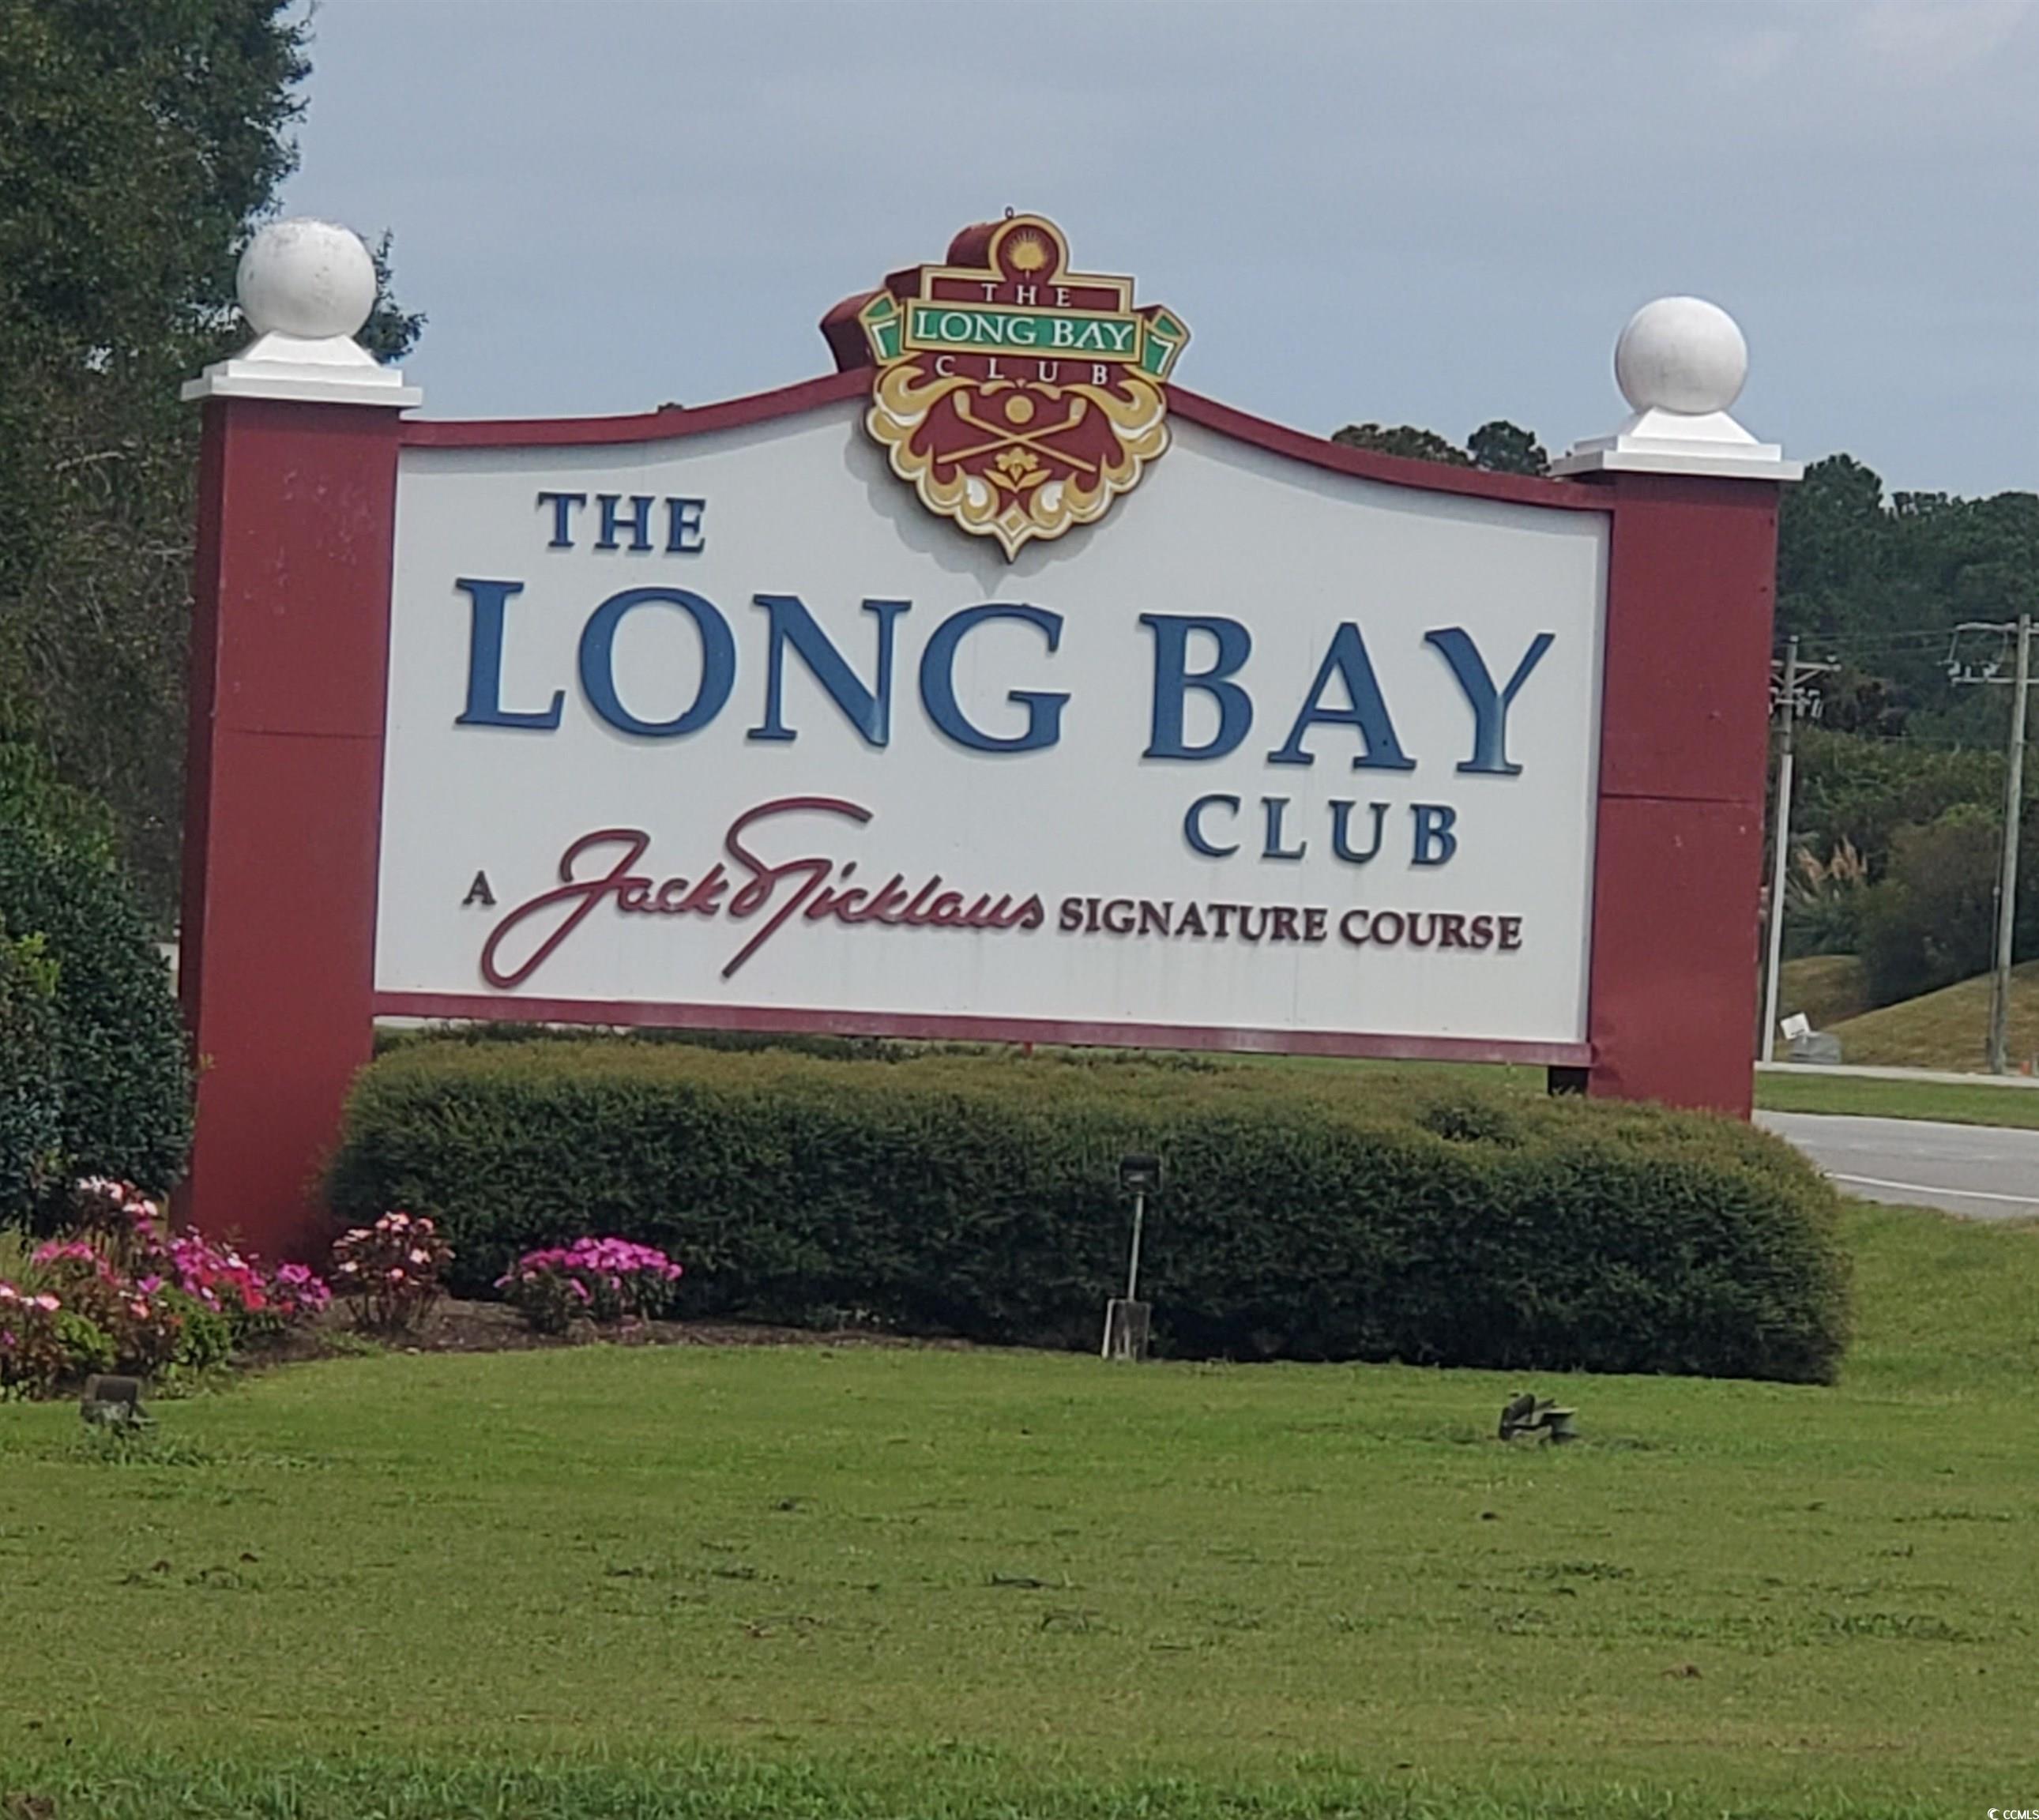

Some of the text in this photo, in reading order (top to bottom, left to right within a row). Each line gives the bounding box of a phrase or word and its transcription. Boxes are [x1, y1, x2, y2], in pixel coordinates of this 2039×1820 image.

[983, 283, 1072, 306] THE
[916, 311, 1133, 351] LONG BAY
[936, 355, 1108, 385] CLUB
[536, 491, 706, 554] THE
[454, 577, 1556, 776] LONG BAY
[1183, 793, 1459, 867] CLUB
[462, 796, 1524, 991] A Jack Nicklaus SIGNATURE COURSE
